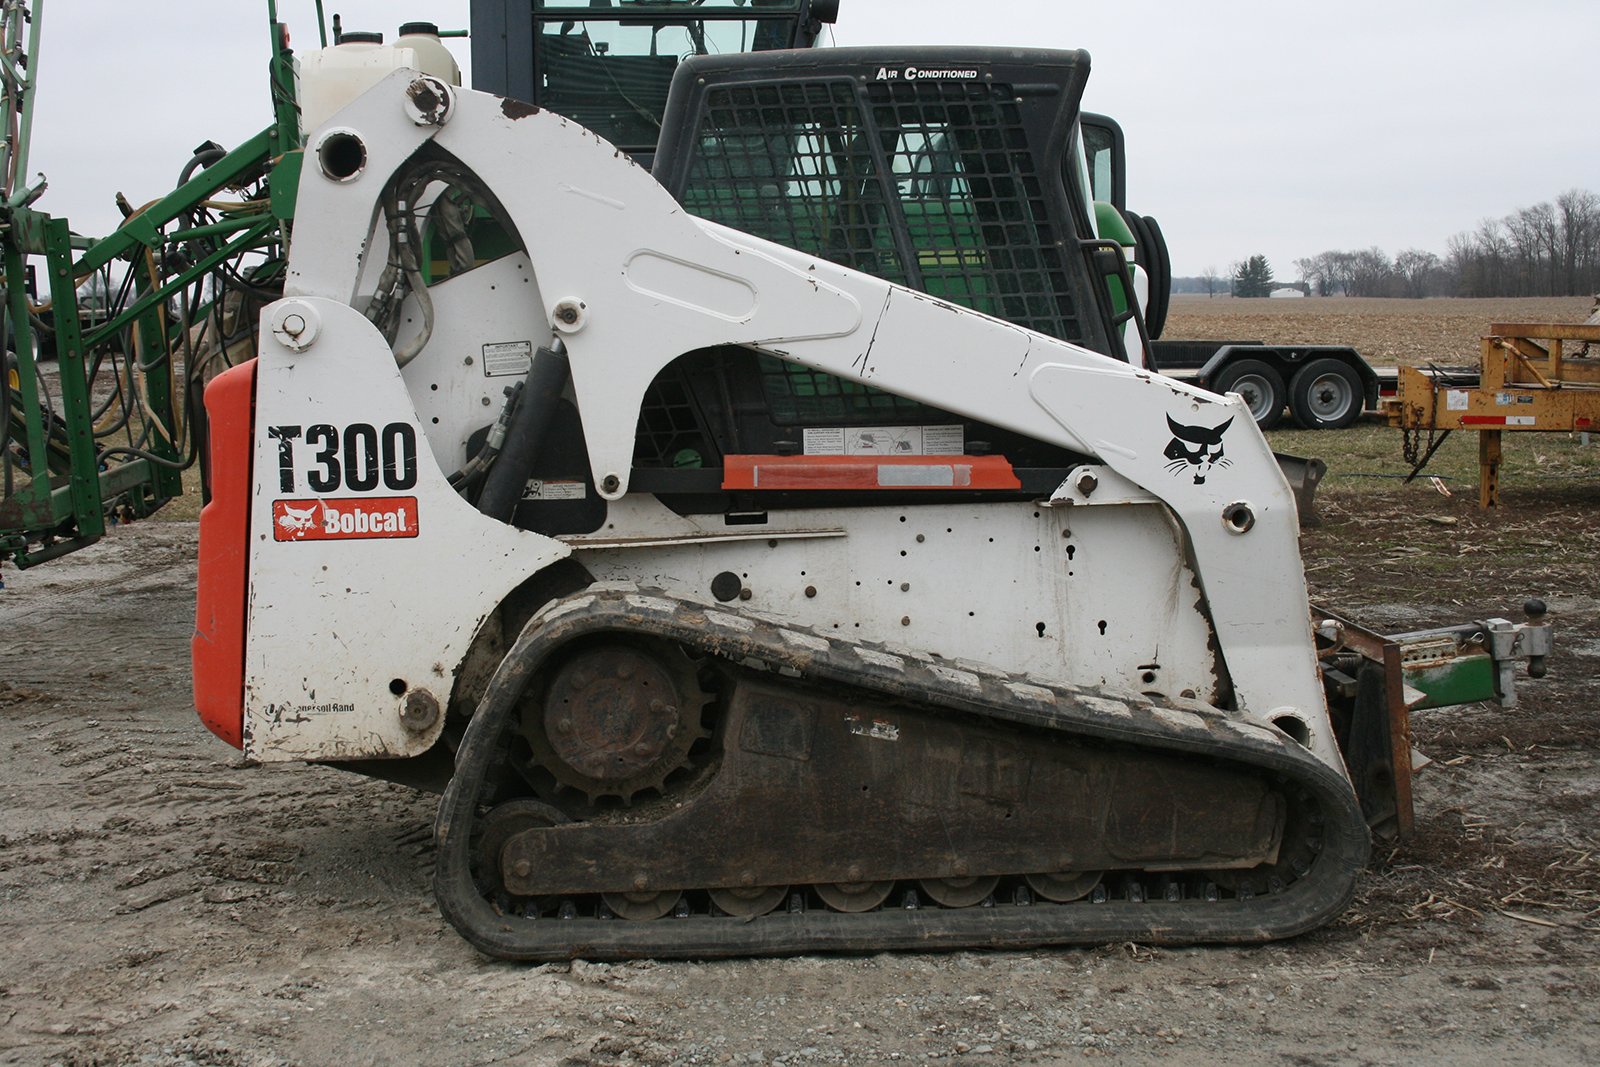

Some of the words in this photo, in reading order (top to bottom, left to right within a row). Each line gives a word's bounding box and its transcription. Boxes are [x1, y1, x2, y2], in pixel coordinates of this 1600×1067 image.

[876, 67, 898, 80] AIR
[904, 67, 977, 80] CONDITIONED
[268, 422, 417, 493] T300
[324, 507, 407, 534] Bobcat
[332, 703, 355, 712] Rand
